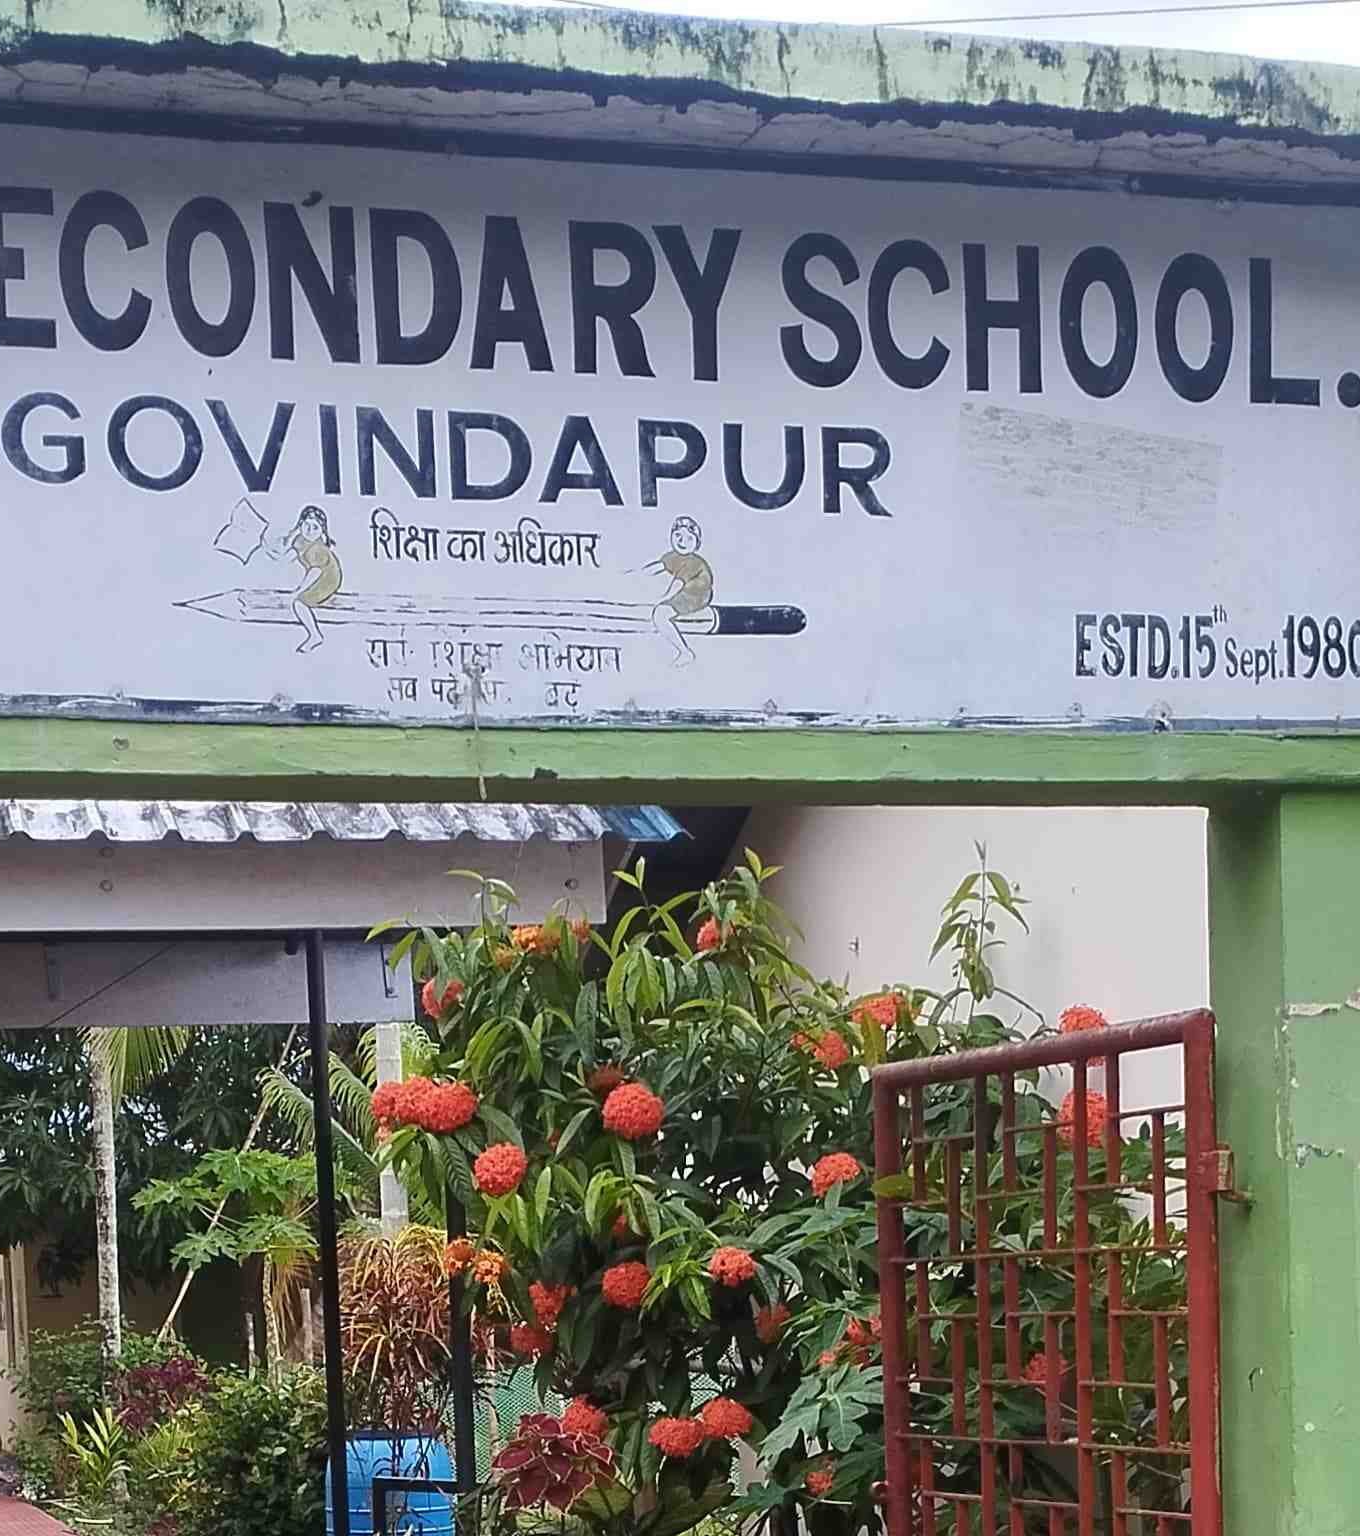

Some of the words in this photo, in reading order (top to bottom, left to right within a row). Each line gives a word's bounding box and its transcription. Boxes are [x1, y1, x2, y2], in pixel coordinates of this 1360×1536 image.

[1, 391, 893, 517] GOVINDAPUR
[370, 507, 440, 562] शिक्षा
[447, 529, 486, 562] का
[493, 516, 601, 568] अधिकार
